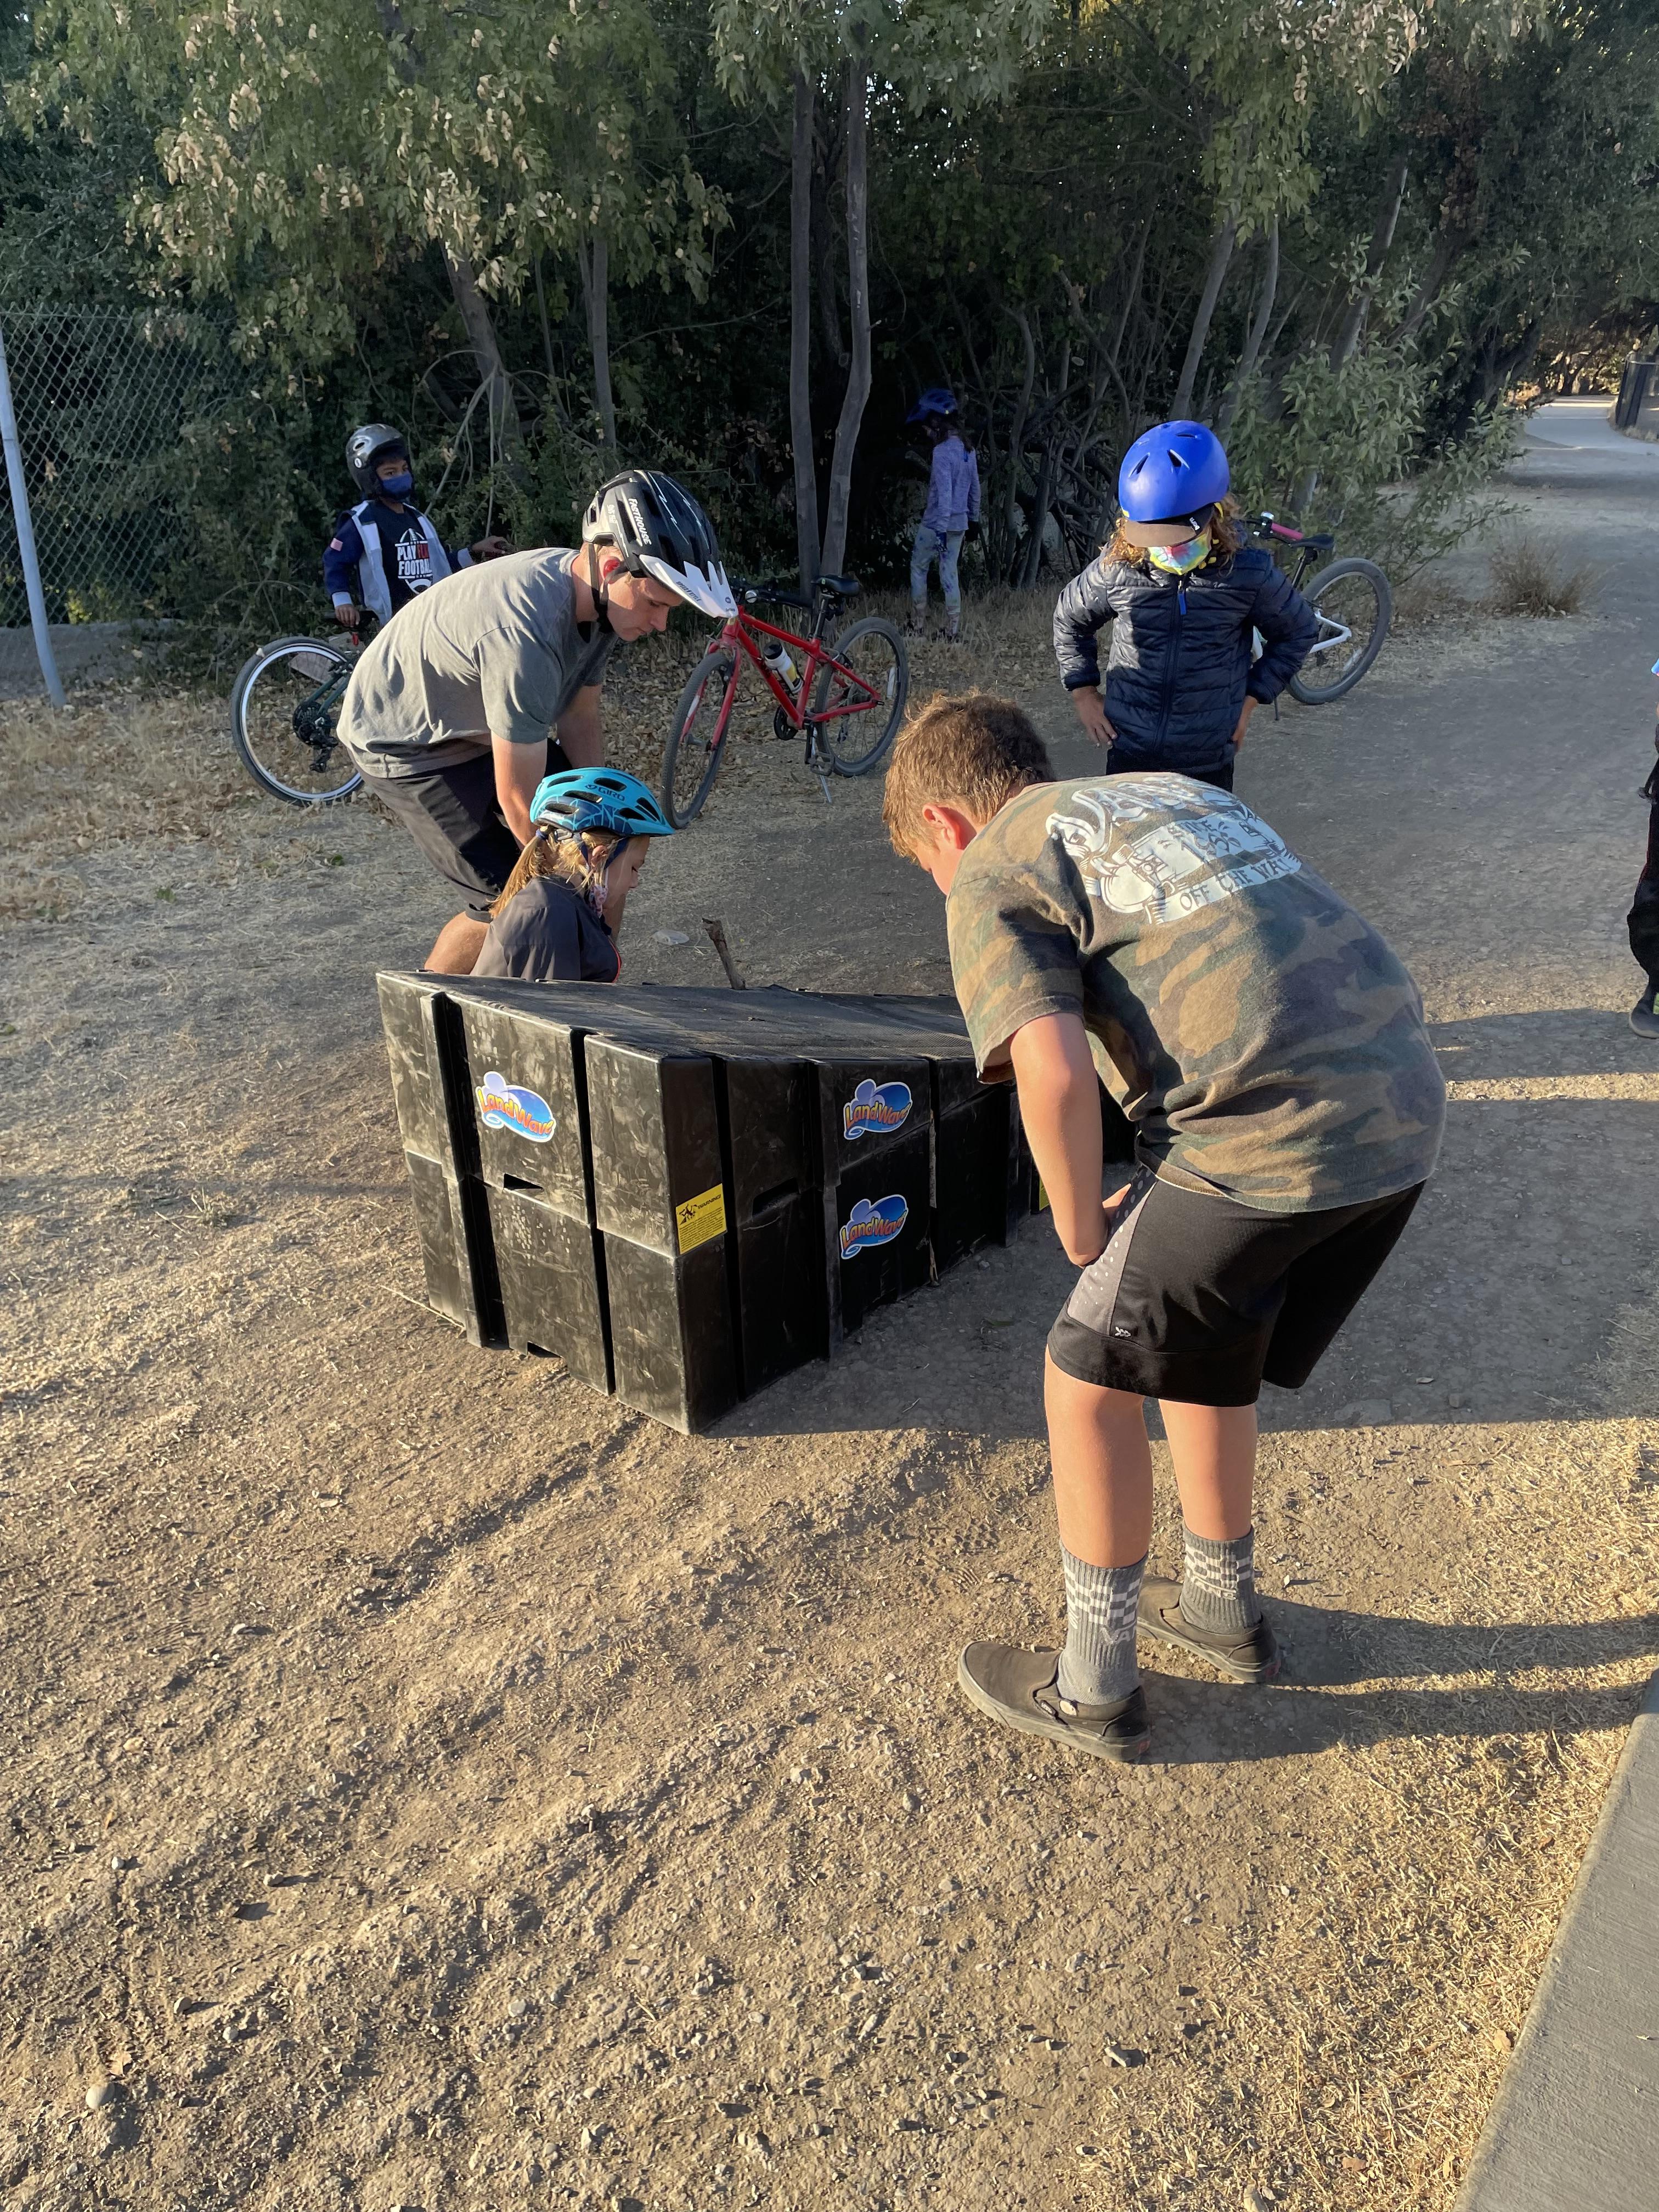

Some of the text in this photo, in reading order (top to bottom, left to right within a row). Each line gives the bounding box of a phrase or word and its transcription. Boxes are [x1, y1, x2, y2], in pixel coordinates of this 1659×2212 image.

[628, 498, 652, 545] FASTHOUSE
[397, 545, 416, 561] PLAY
[599, 787, 625, 801] GIRO
[1180, 884, 1209, 911] OFF
[1216, 870, 1253, 893] THE
[477, 1088, 554, 1135] LandWave
[845, 1101, 912, 1130] LandWave
[842, 1210, 907, 1250] LandWave
